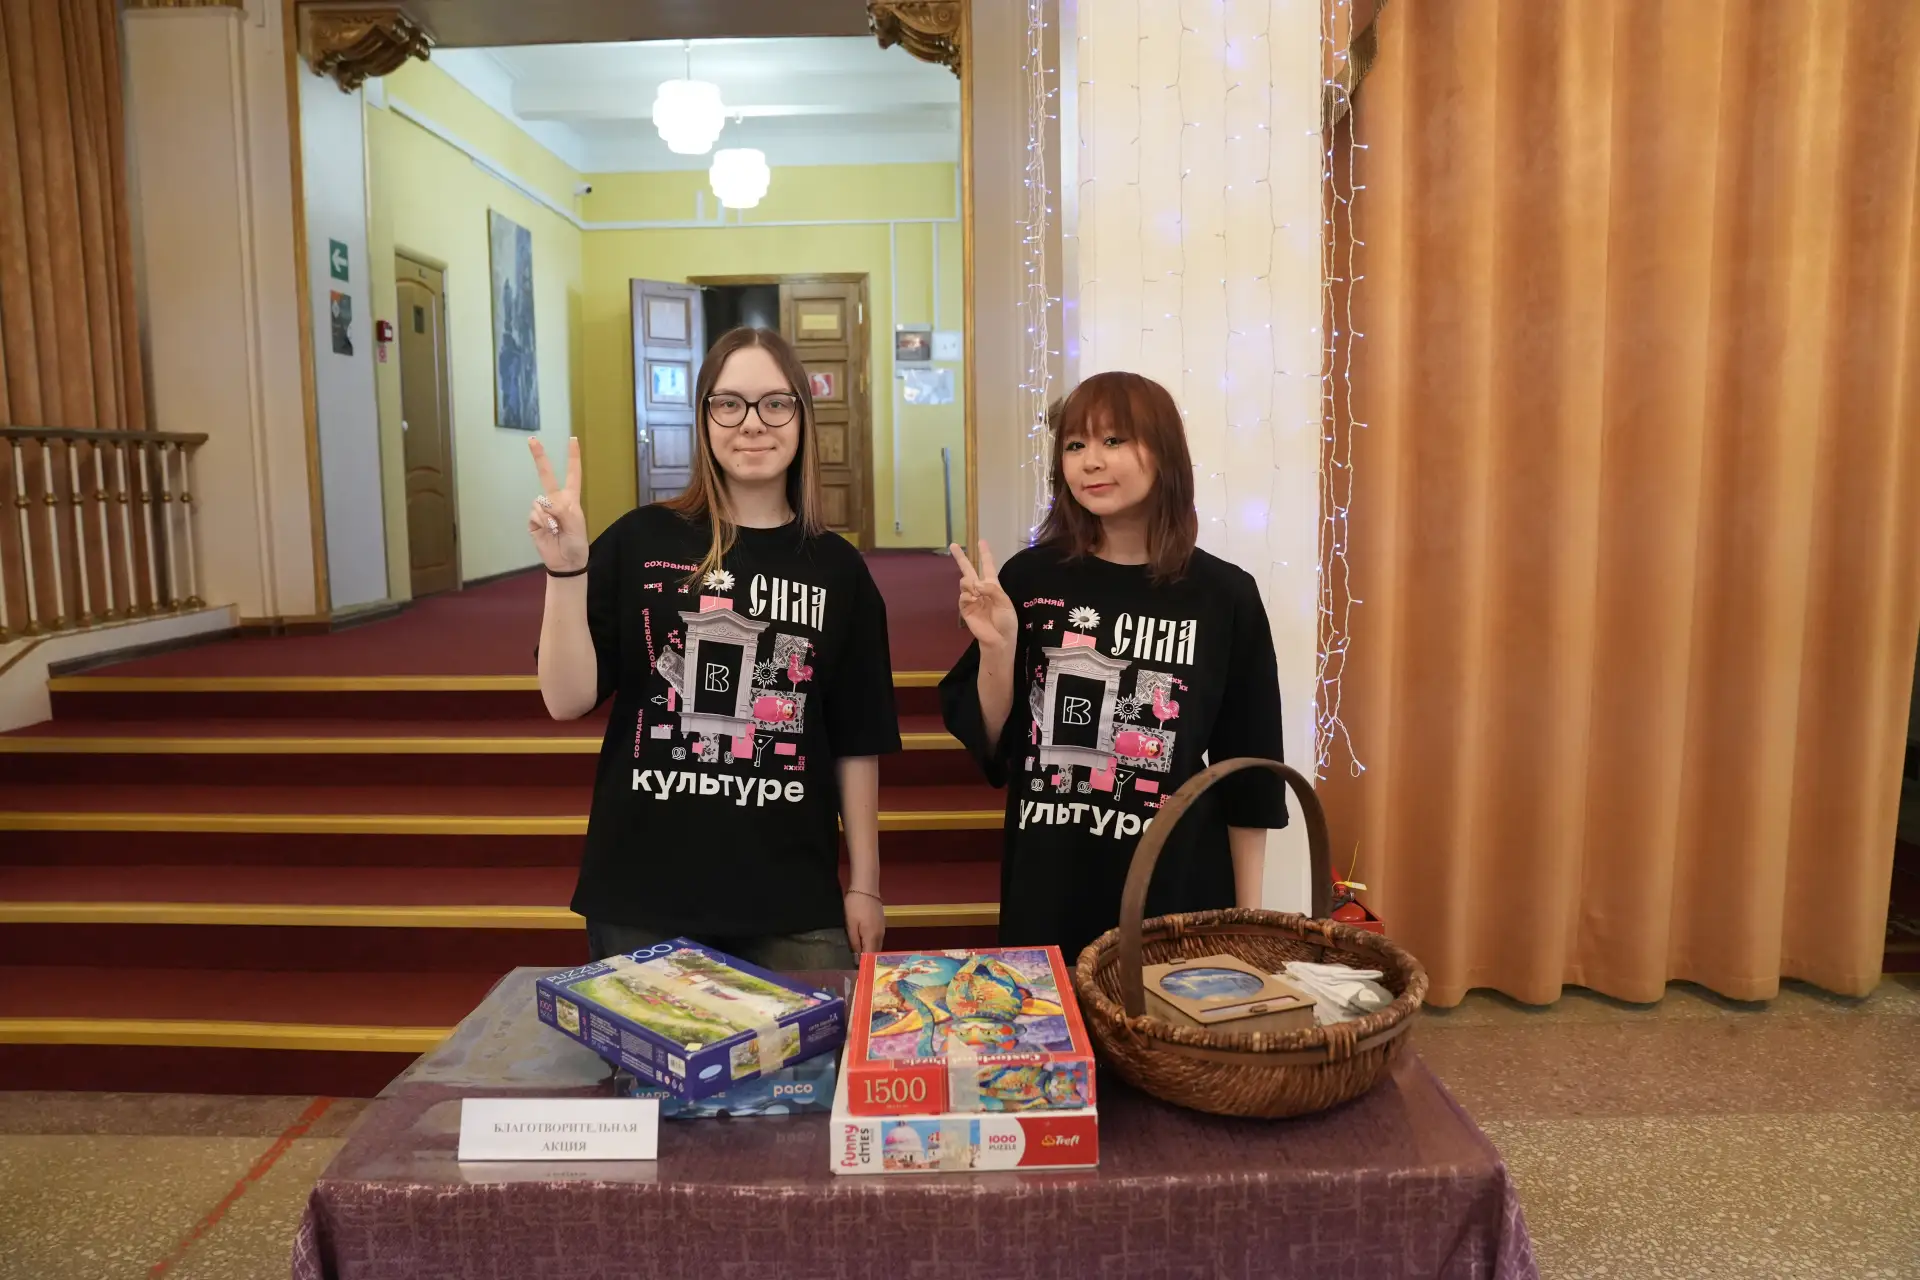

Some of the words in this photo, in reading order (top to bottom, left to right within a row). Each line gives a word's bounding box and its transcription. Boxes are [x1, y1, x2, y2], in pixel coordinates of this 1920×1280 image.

[644, 560, 698, 572] сохраняй
[632, 768, 805, 807] культуре
[1019, 799, 1154, 840] ультур
[774, 1084, 813, 1098] paco
[864, 1077, 927, 1104] 1500
[493, 1123, 638, 1133] БЛАГОТВОРИТЕЛЬНАЯ
[840, 1124, 859, 1168] funny
[989, 1134, 1017, 1144] 1000
[541, 1141, 587, 1153] АКЦИЯ
